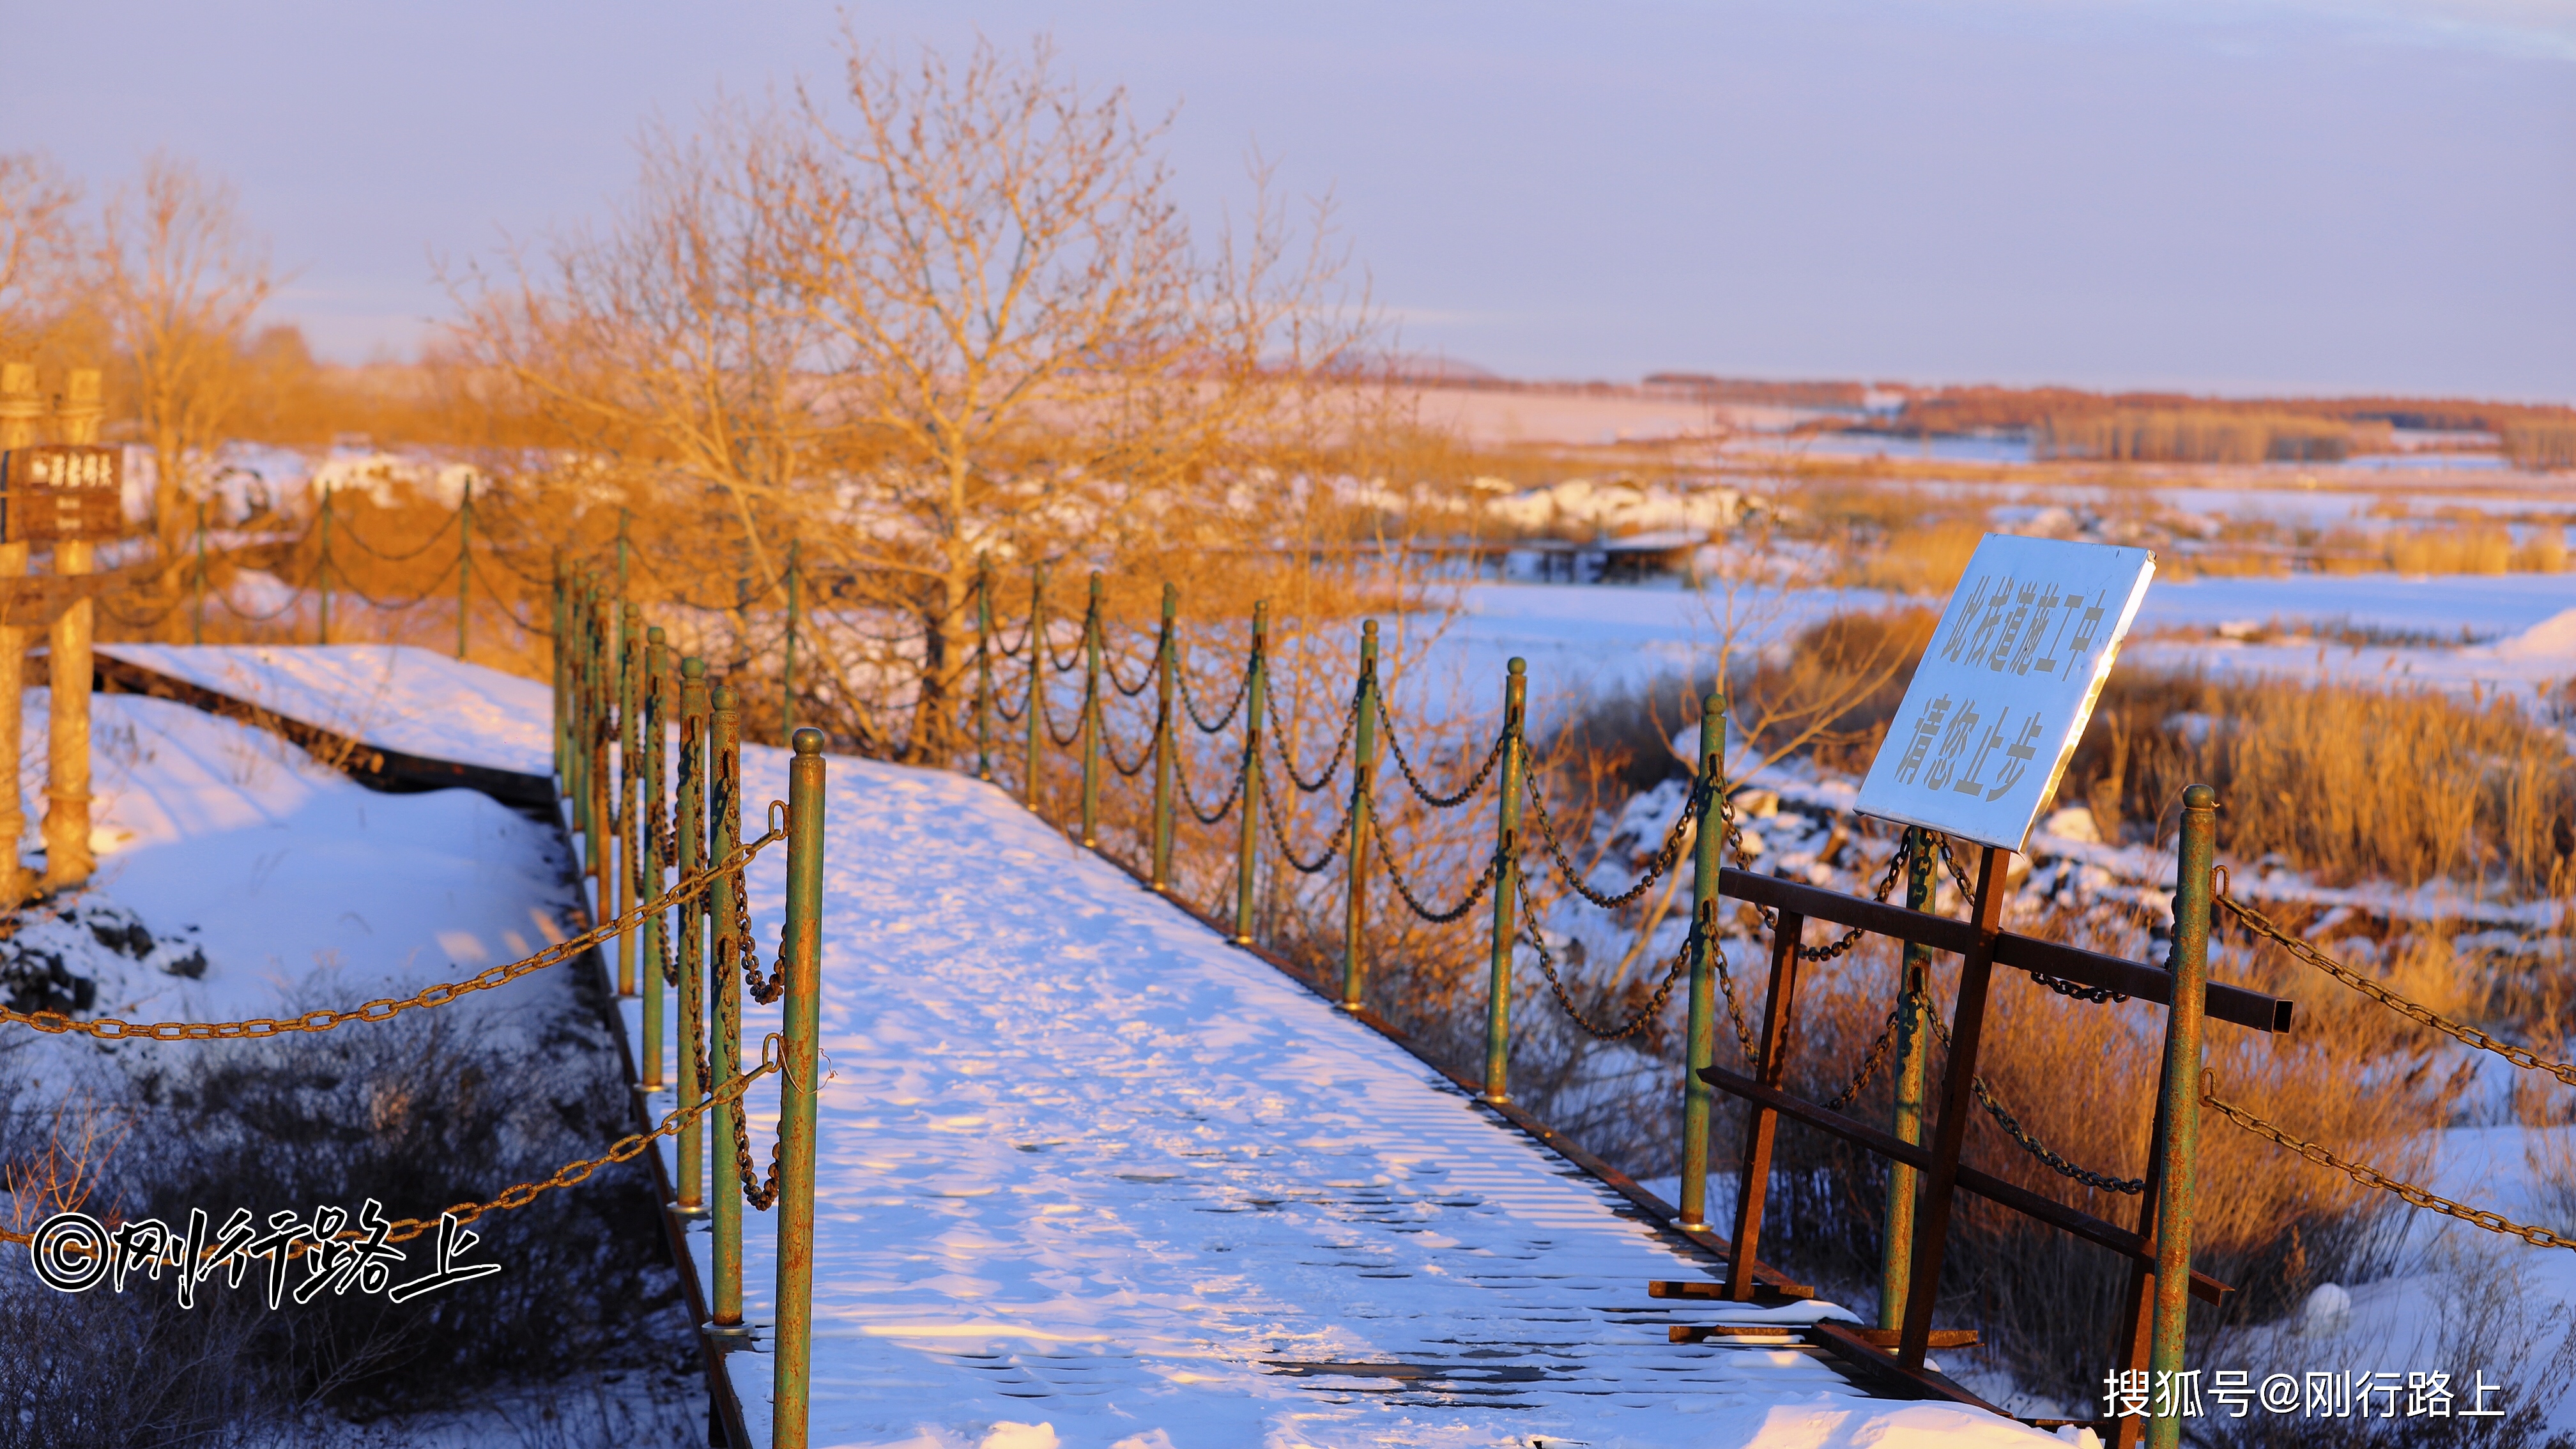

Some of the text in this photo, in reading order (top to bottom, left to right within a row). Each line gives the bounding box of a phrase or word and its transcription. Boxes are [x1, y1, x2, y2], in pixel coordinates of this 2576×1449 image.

[1940, 576, 2105, 682] 此栈道施工中
[1894, 693, 2043, 802] 请您止步
